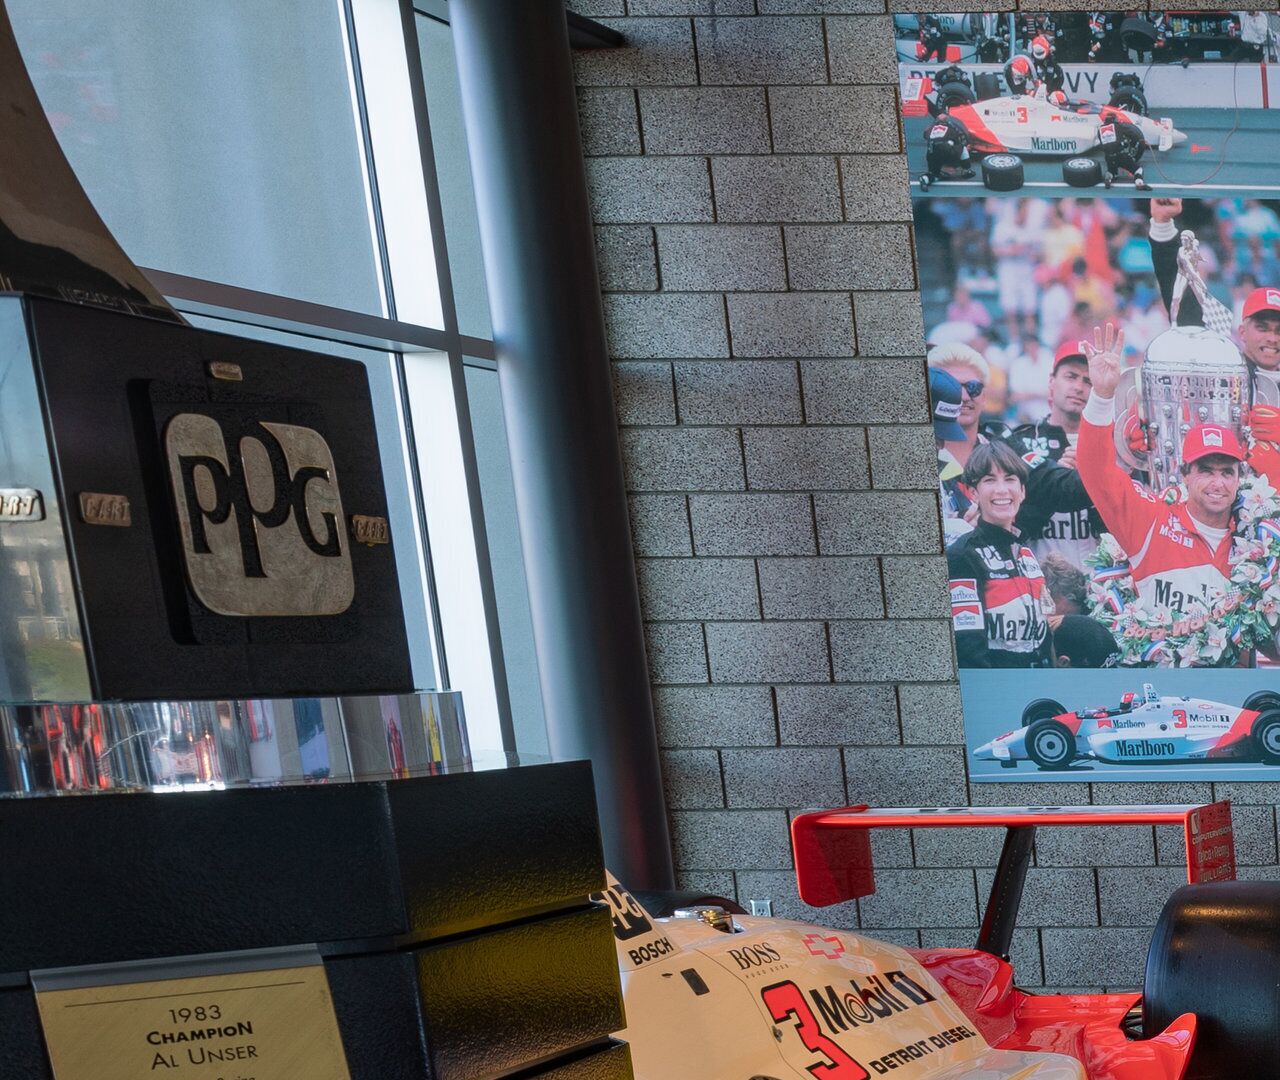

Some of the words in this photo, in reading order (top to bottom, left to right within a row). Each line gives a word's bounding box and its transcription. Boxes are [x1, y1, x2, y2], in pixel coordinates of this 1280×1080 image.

[1016, 106, 1029, 124] 3
[1031, 136, 1077, 151] Marlboro
[1113, 719, 1146, 729] Marlboro
[1172, 709, 1188, 729] 3
[1189, 714, 1218, 723] Mobil
[1115, 739, 1175, 757] Marlboro
[627, 936, 675, 966] BOSCH
[728, 941, 782, 971] BOSS
[169, 1004, 222, 1025] 1983
[815, 974, 903, 1037] Mobil
[146, 1020, 254, 1047] CHAMPION
[188, 1044, 259, 1066] UNSER
[868, 1039, 931, 1077] DETROIT
[930, 1023, 978, 1058] DIESEL
